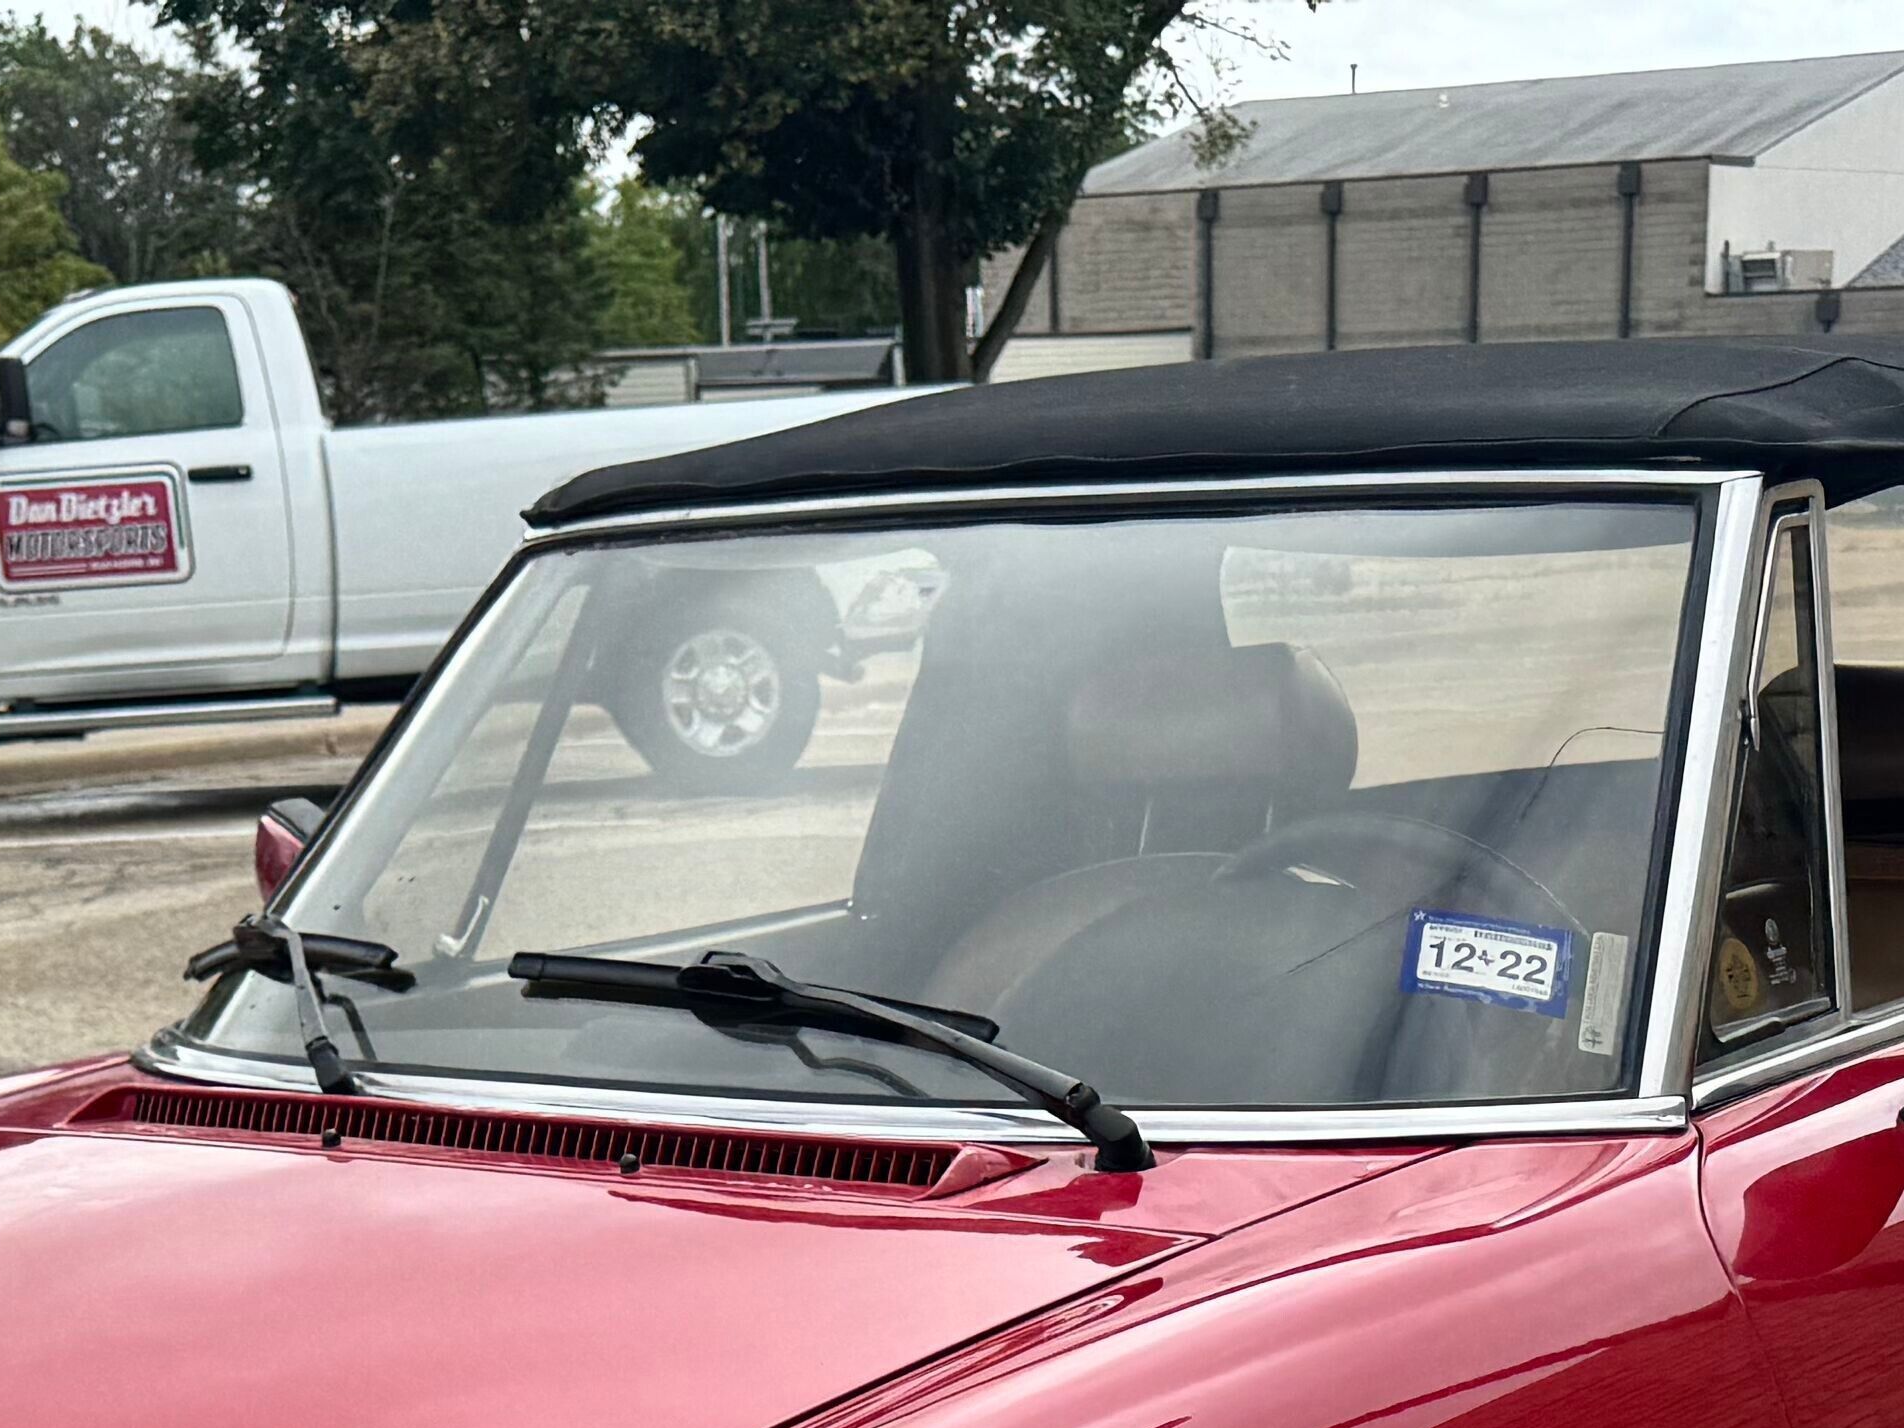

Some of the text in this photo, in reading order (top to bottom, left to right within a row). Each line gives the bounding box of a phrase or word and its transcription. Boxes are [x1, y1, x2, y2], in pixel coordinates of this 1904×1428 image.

[8, 494, 57, 526] Dan
[4, 522, 169, 562] MOTORSPORTS
[1429, 937, 1548, 985] 12 22
